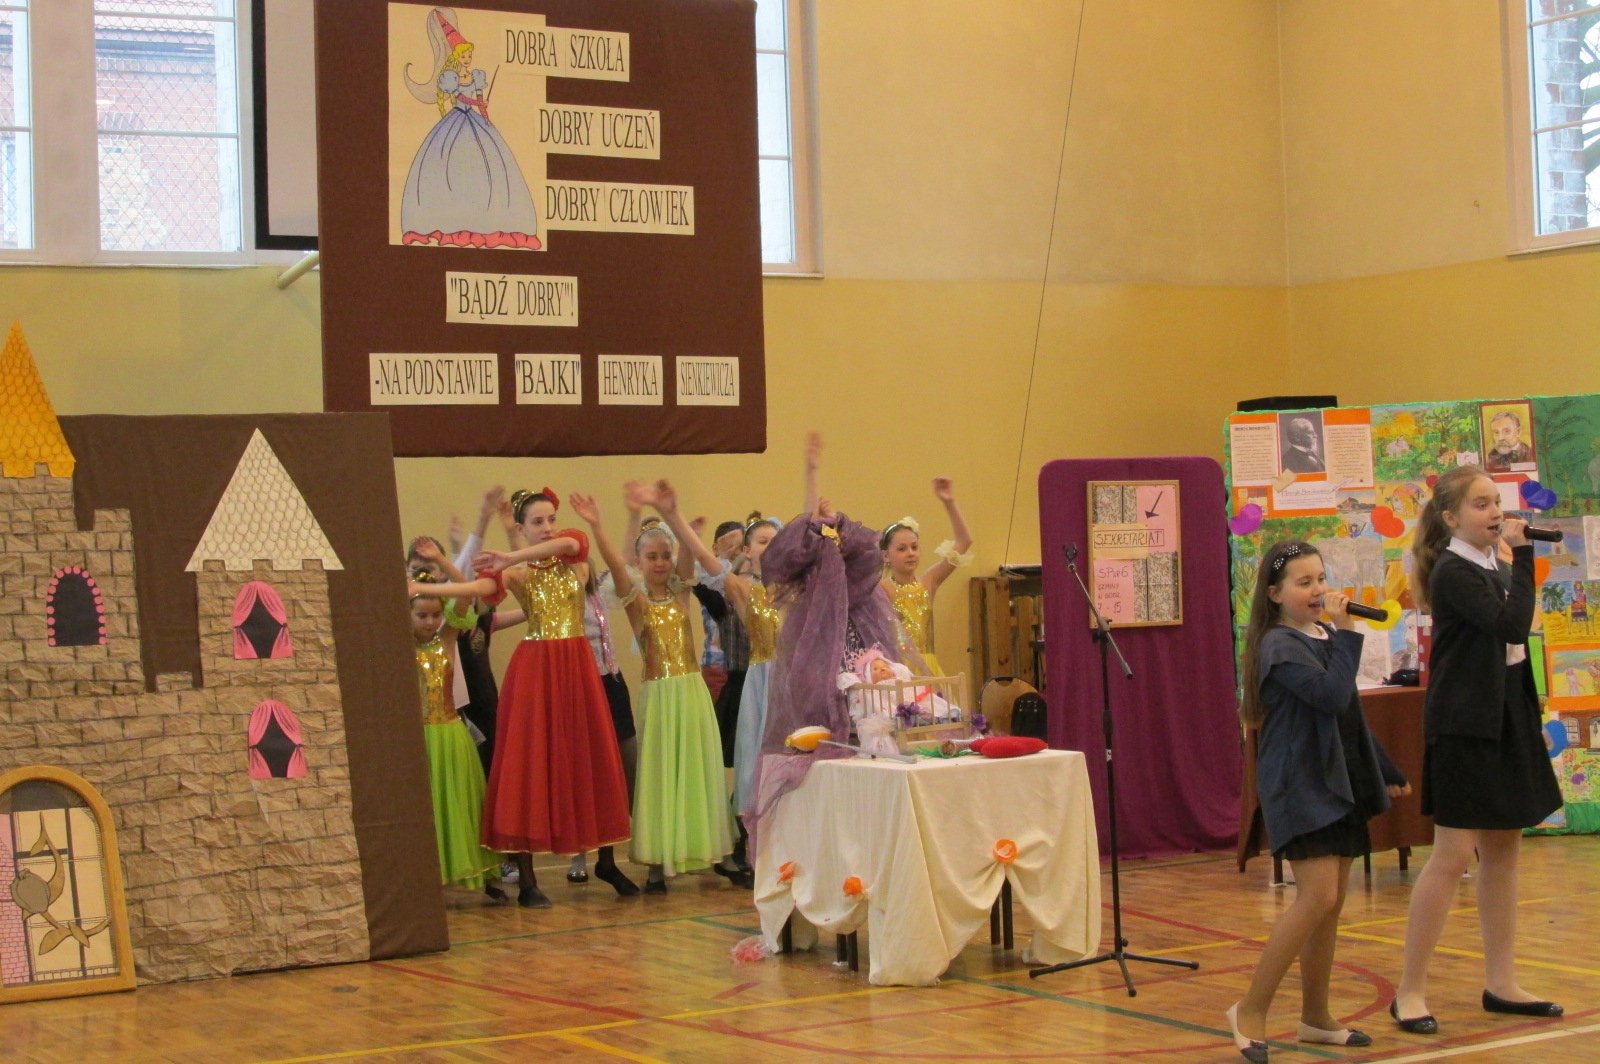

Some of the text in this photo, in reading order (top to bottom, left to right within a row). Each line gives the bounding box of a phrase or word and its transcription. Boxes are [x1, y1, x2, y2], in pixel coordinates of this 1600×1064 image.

[505, 29, 625, 72] DOBRA SZKOŁA
[539, 108, 656, 150] DOBRY UCZEŃ
[545, 185, 690, 226] DOBRY CZŁOWIEK
[603, 360, 658, 396] HENRYKA
[680, 361, 735, 397] SIENKIEWICZA
[1095, 531, 1162, 546] SEKRETARIAT
